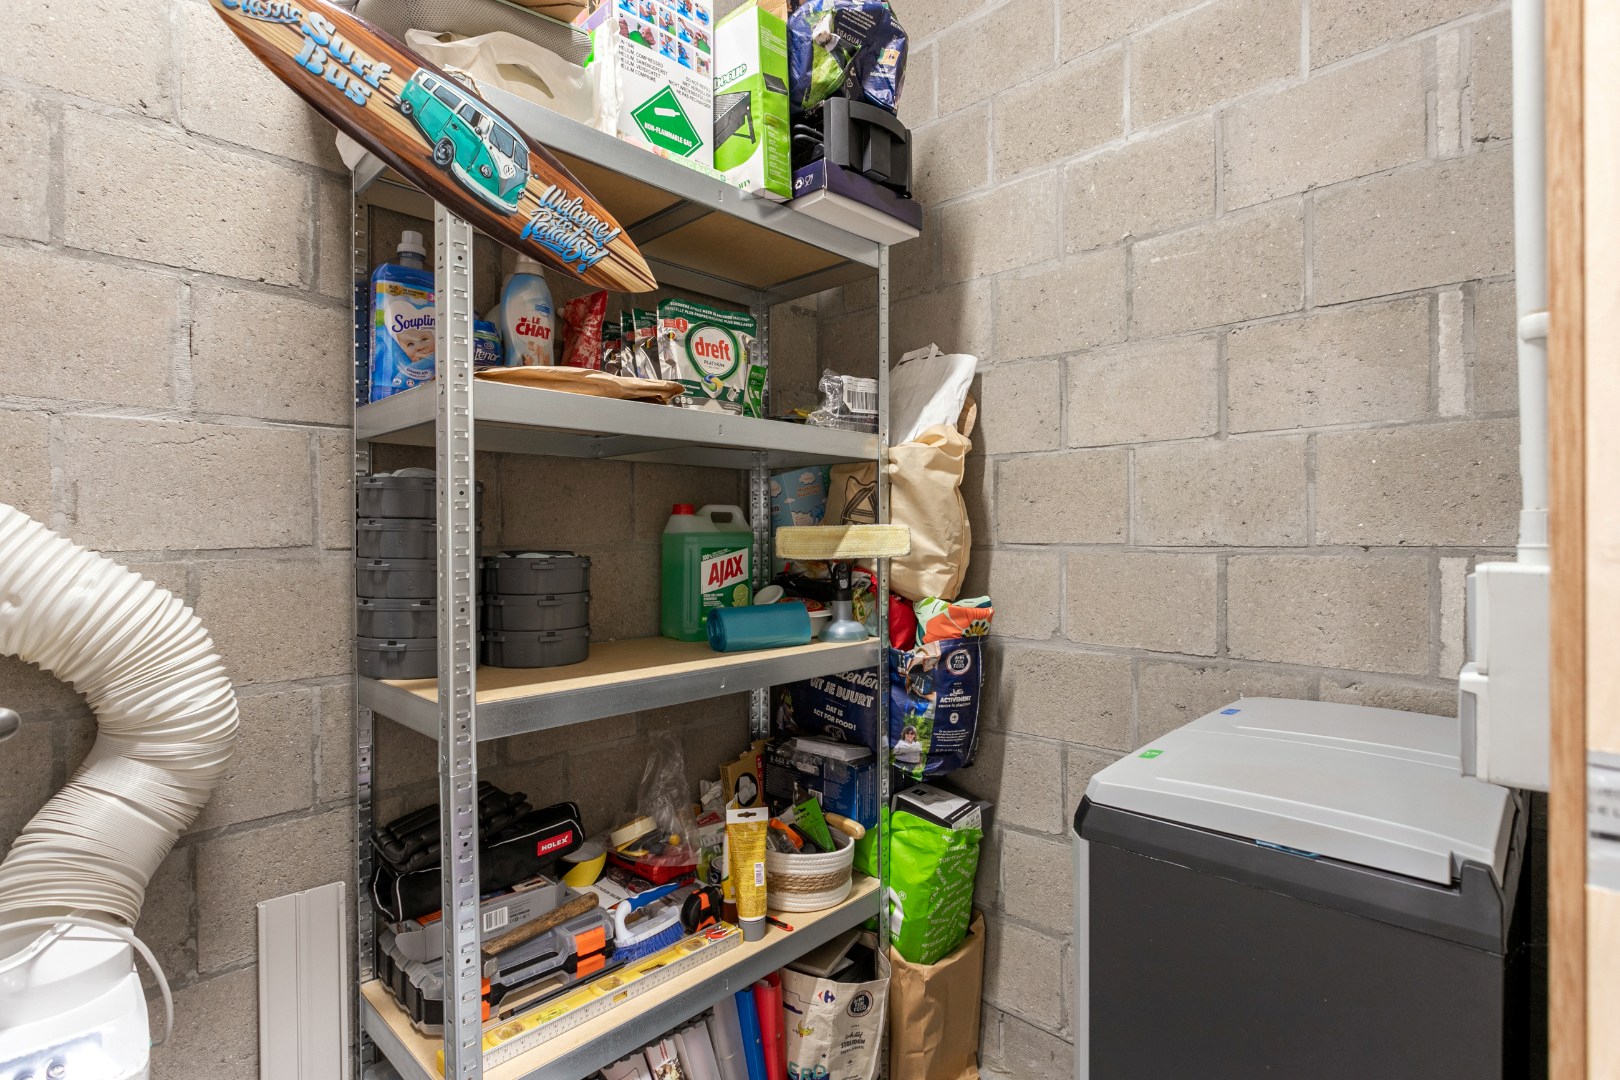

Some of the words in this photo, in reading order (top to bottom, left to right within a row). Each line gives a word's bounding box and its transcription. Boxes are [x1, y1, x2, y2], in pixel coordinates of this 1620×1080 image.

[300, 11, 392, 90] Surf
[294, 37, 372, 107] Bus
[644, 122, 683, 144] NON-FLAMMABLE
[683, 138, 693, 148] GAS
[540, 184, 621, 249] Welcome!
[520, 207, 610, 274] Paradise!
[392, 314, 435, 333] Souplin
[515, 322, 551, 340] CHAT
[532, 316, 541, 325] LE
[695, 337, 731, 362] dreft
[708, 554, 743, 588] AJAX
[810, 677, 825, 690] UIT
[824, 681, 836, 696] JE
[836, 685, 875, 708] BUURT
[824, 712, 835, 723] FOR
[826, 704, 837, 714] DAT
[837, 708, 844, 717] IS
[541, 835, 569, 852] HOLEX
